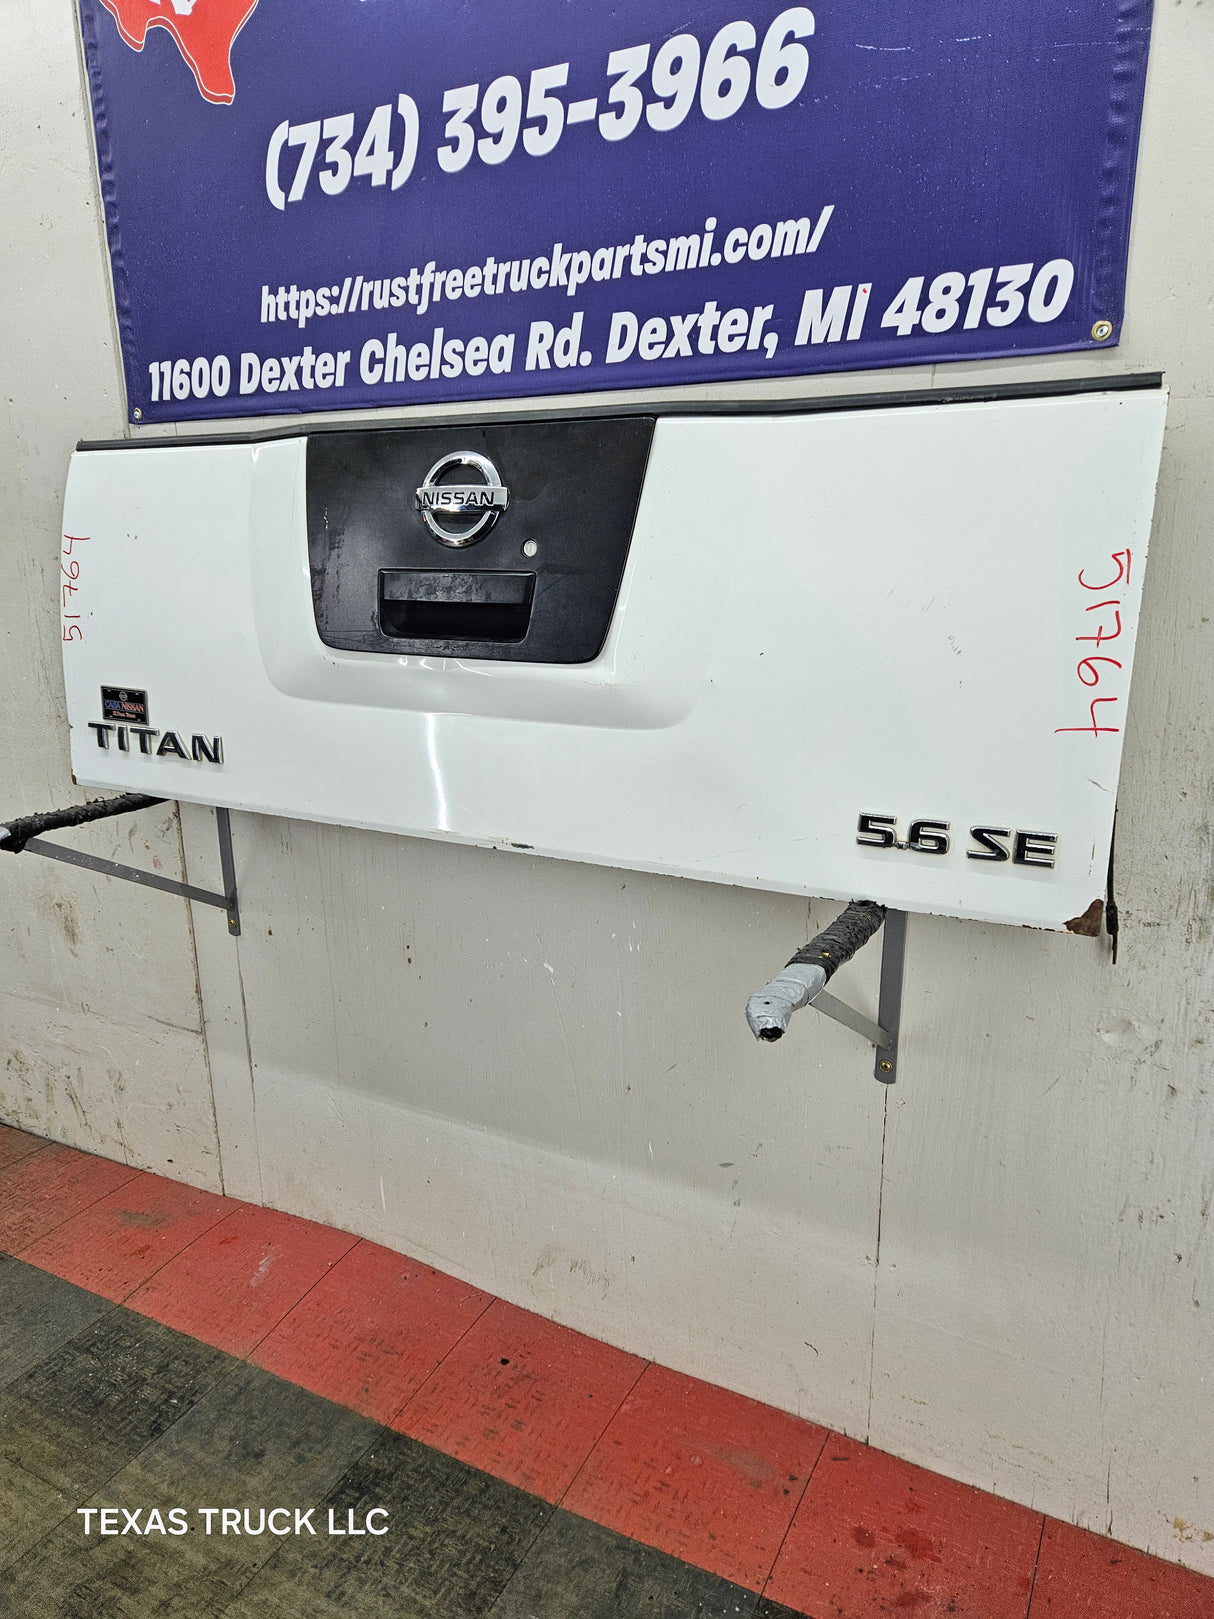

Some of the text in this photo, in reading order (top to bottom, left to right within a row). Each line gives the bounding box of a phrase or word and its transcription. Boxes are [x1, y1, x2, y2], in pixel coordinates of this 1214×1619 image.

[266, 7, 816, 210] (734) 395-3966
[260, 204, 835, 328] https://rustfreetruckpartsmi.com/
[149, 258, 1075, 401] 11600 Dexter Chelsea Rd. Dexter, MI 48130
[421, 490, 496, 507] NISSAN
[61, 534, 91, 641] 51764
[1054, 548, 1132, 738] 51764
[87, 721, 225, 764] TITAN
[856, 811, 1059, 869] 5.6 SE
